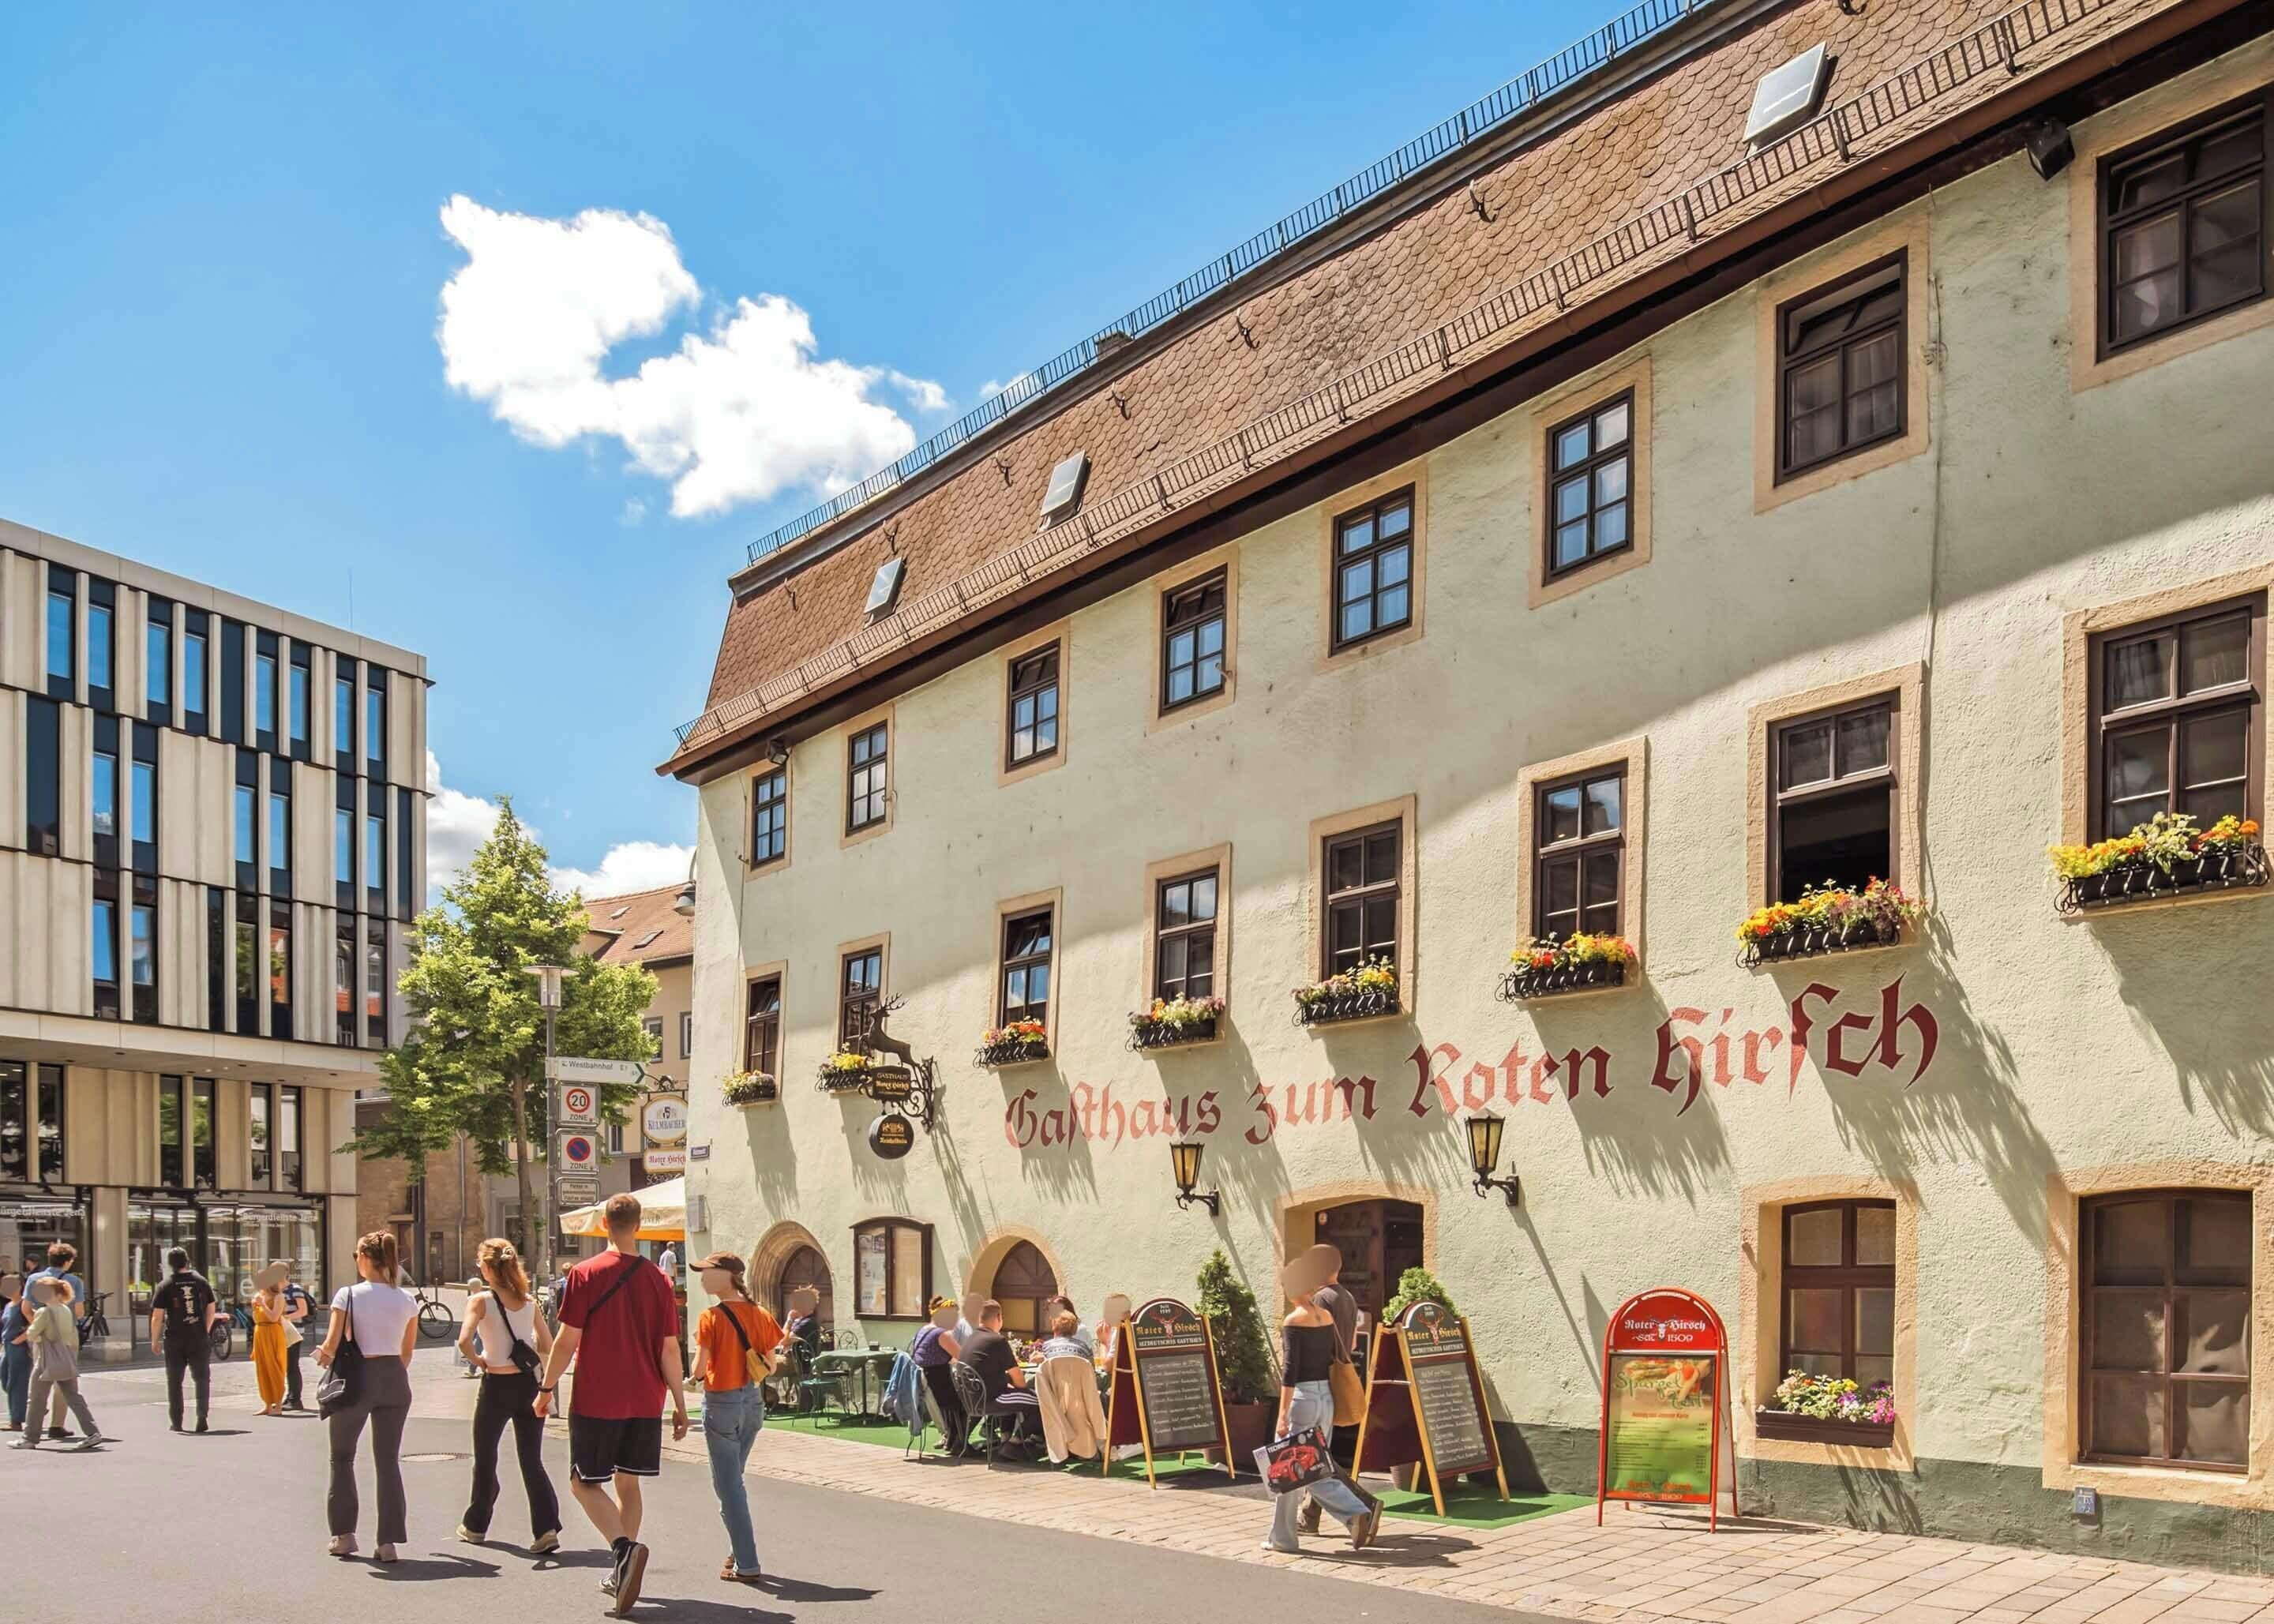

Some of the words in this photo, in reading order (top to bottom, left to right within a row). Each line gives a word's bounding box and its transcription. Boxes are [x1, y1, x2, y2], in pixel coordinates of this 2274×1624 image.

[1244, 1074, 1381, 1145] zum
[1404, 1036, 1616, 1119] Roten
[1650, 971, 1939, 1118] Hirsch
[568, 1060, 614, 1071] Westbahnhof
[571, 1094, 587, 1108] 20
[1625, 1319, 1655, 1330] Roter
[1669, 1319, 1706, 1331] Hirsch
